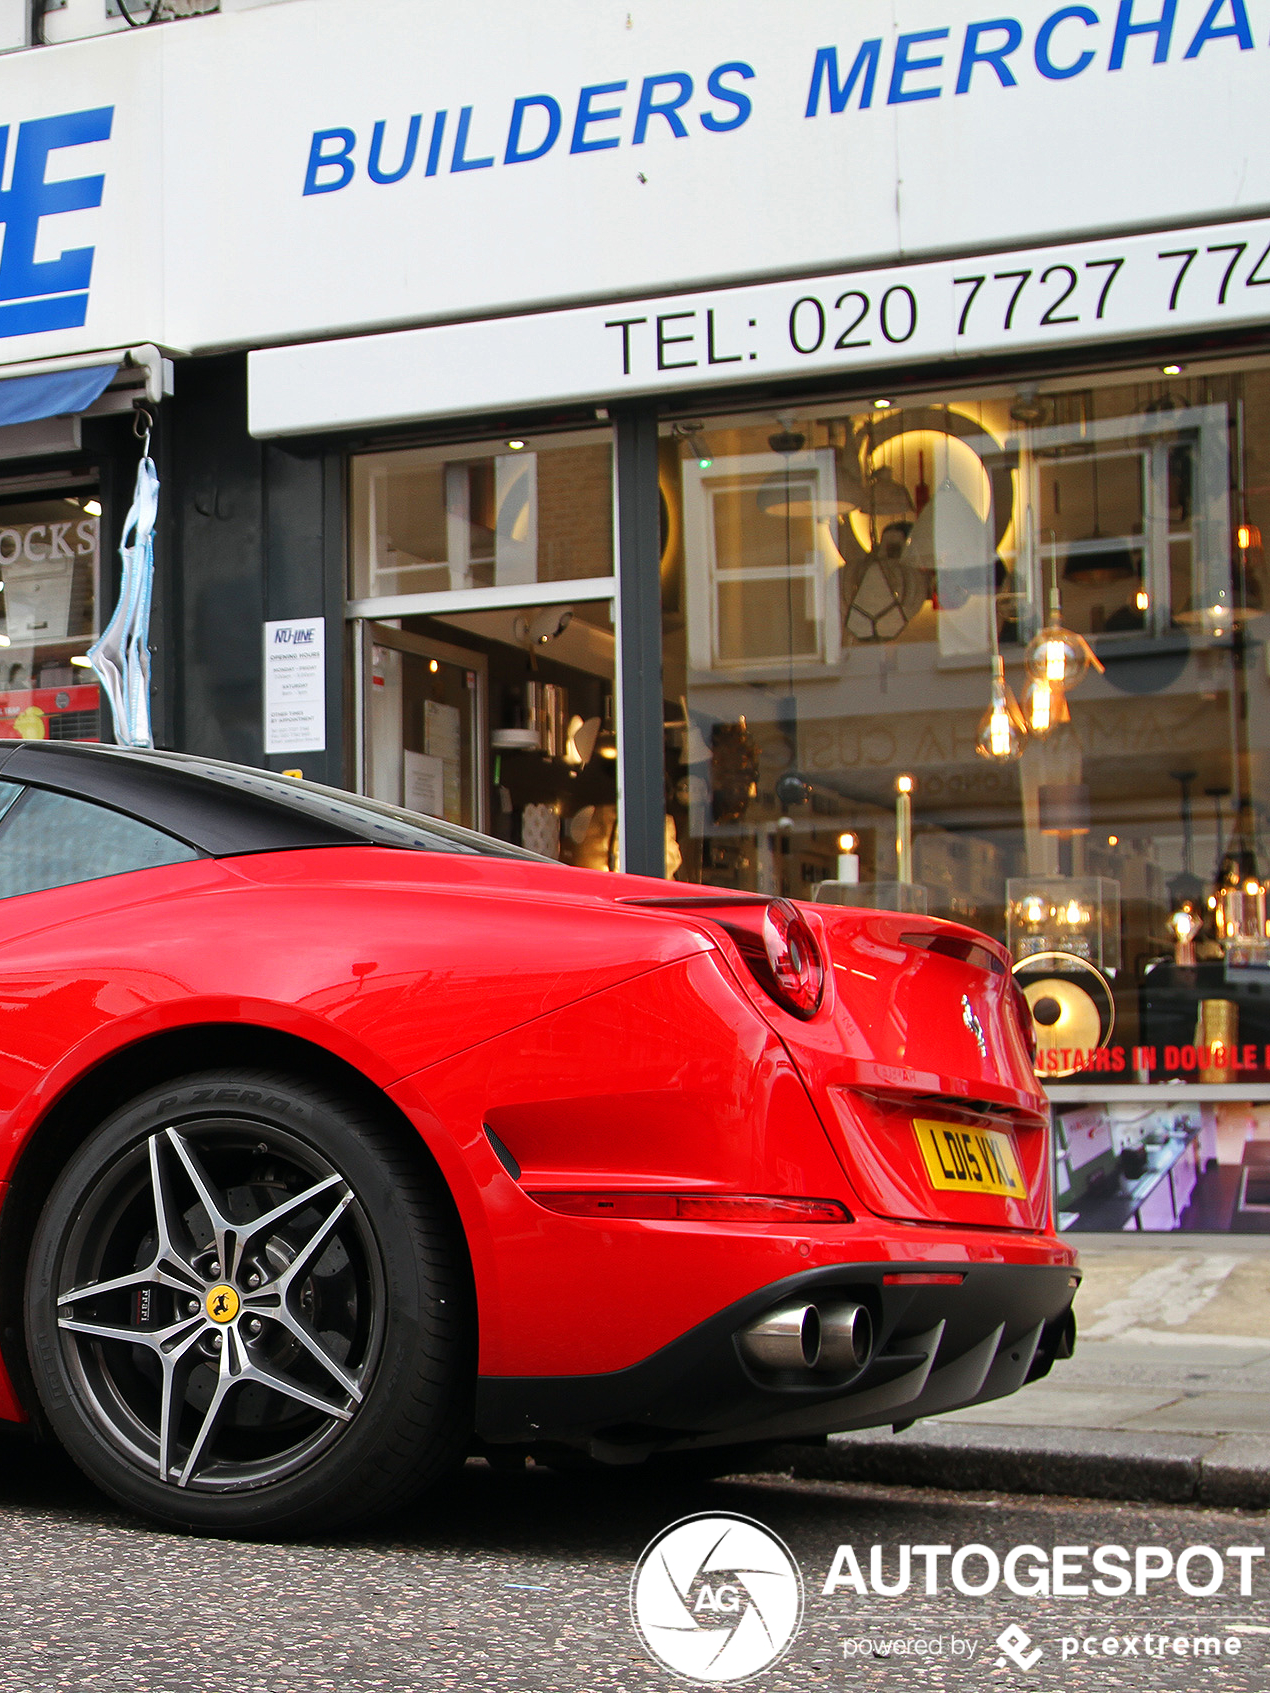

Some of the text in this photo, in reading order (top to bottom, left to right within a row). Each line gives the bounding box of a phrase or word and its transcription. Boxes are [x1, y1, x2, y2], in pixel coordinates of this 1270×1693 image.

[301, 0, 1270, 198] BUILDERS MERCHA
[603, 308, 759, 376] TEL:
[788, 284, 918, 355] 020
[953, 257, 1127, 336] 7727
[274, 627, 316, 645] NU-LINE
[1132, 1045, 1157, 1071] IN
[1164, 1044, 1258, 1071] DOUBLE
[156, 1088, 291, 1116] P ZERO
[930, 1129, 983, 1182] LD15
